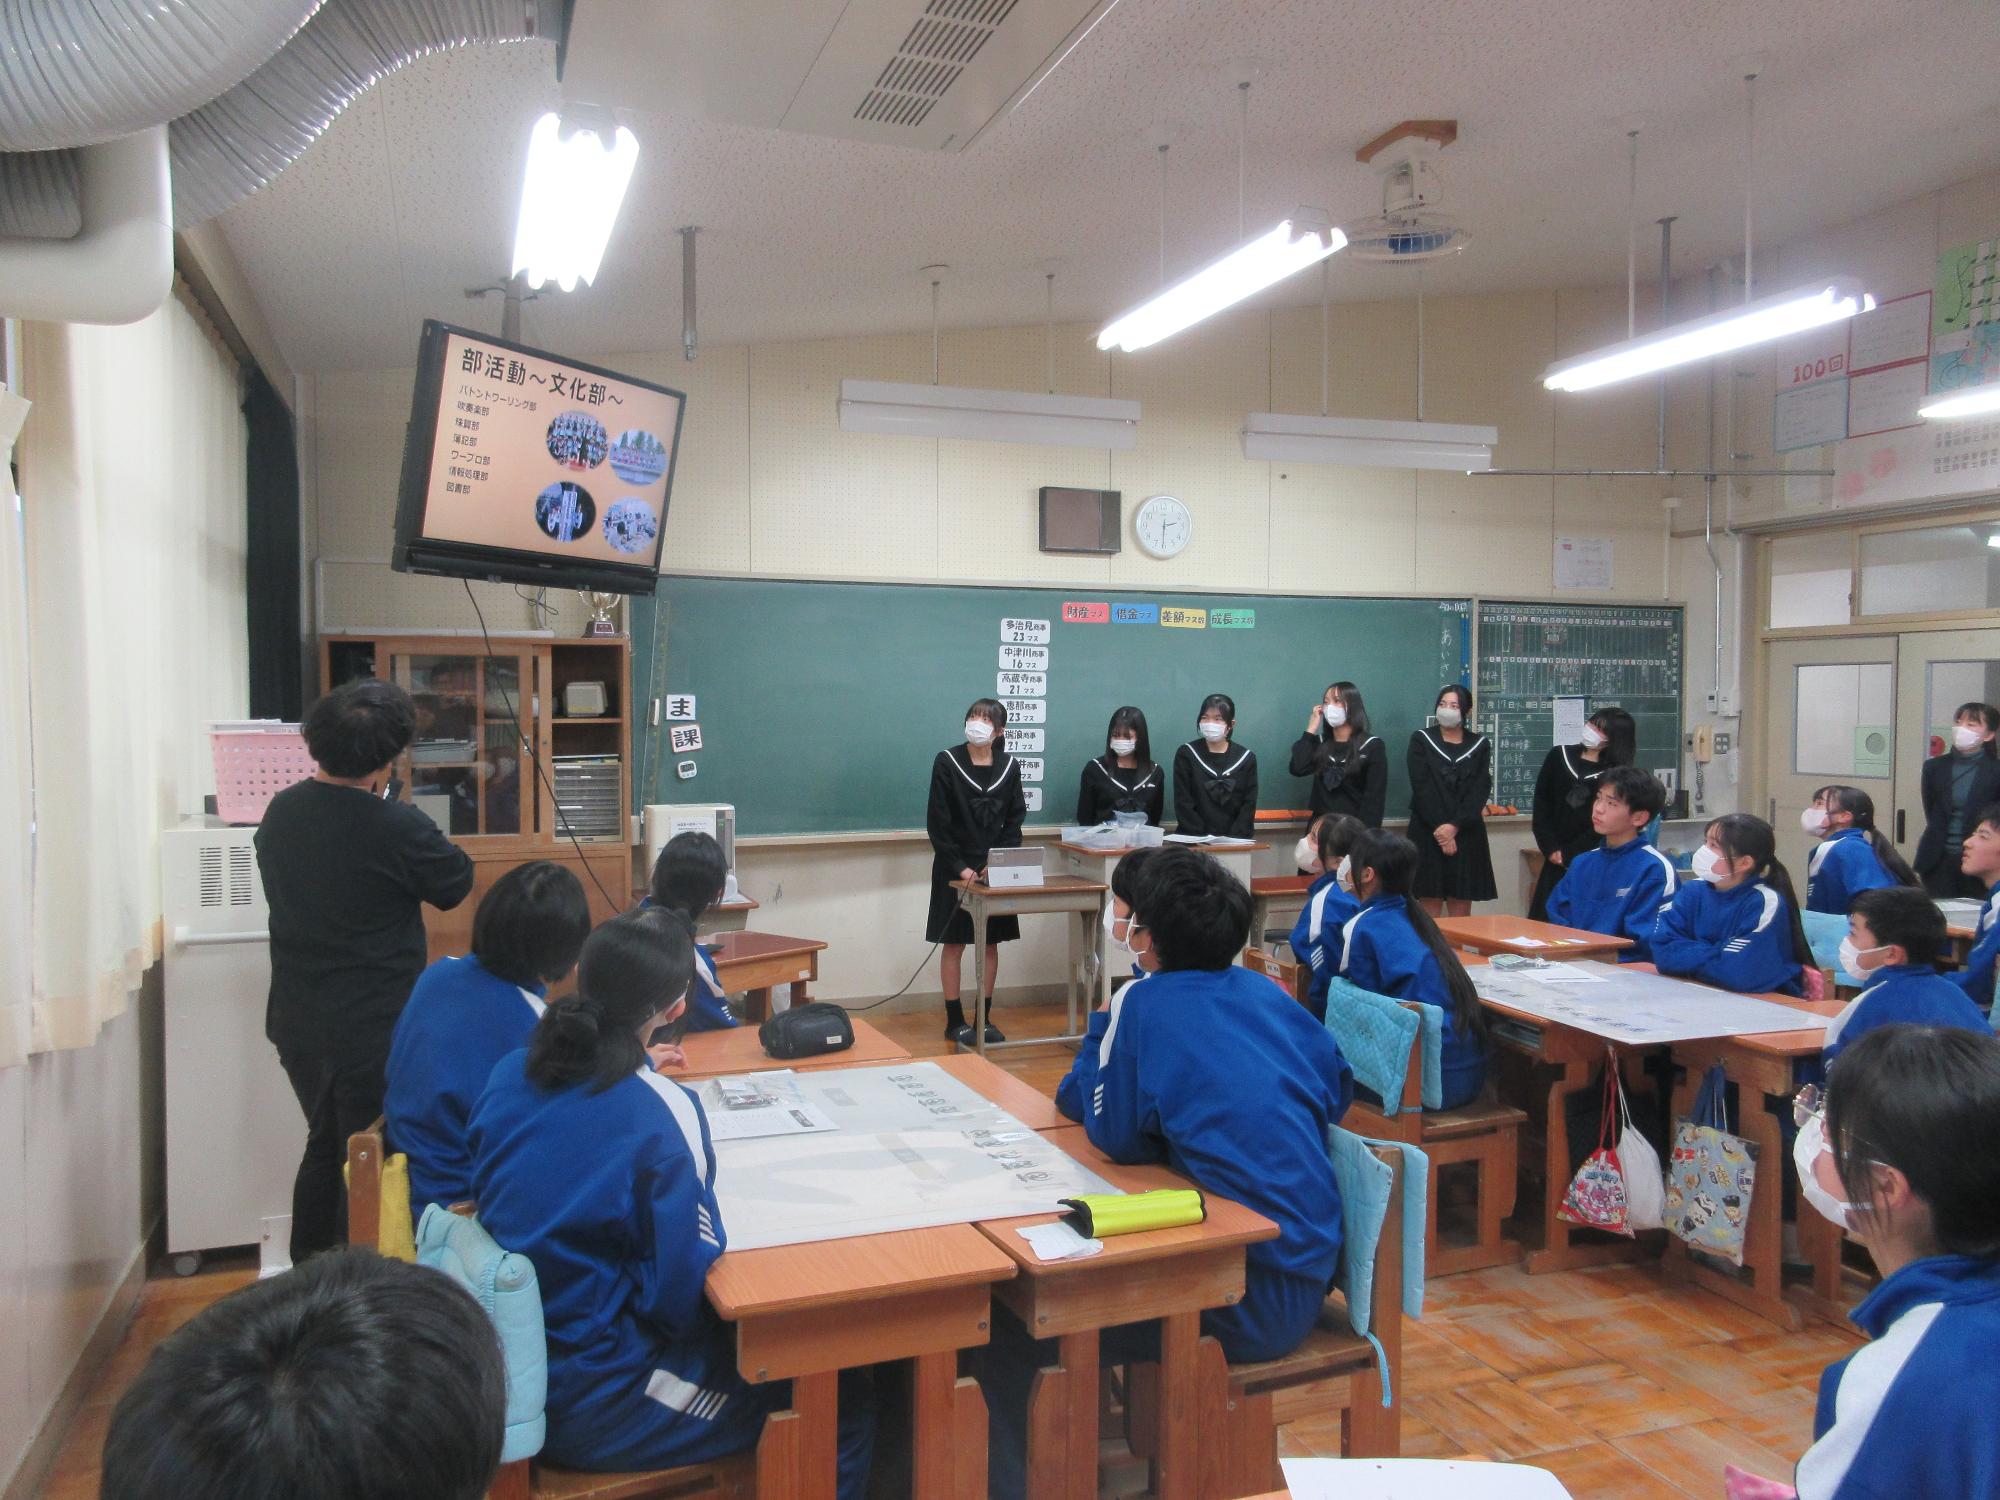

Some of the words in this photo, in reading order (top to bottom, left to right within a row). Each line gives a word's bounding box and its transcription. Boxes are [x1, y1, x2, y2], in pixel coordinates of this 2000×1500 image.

[457, 401, 490, 416] 吹奏楽部
[451, 450, 491, 465] ワープロ部
[449, 466, 489, 481] 情報処理部
[446, 481, 471, 495] 図書部
[1004, 647, 1045, 658] 中津川商事
[670, 697, 691, 717] ま
[672, 728, 701, 748] 課
